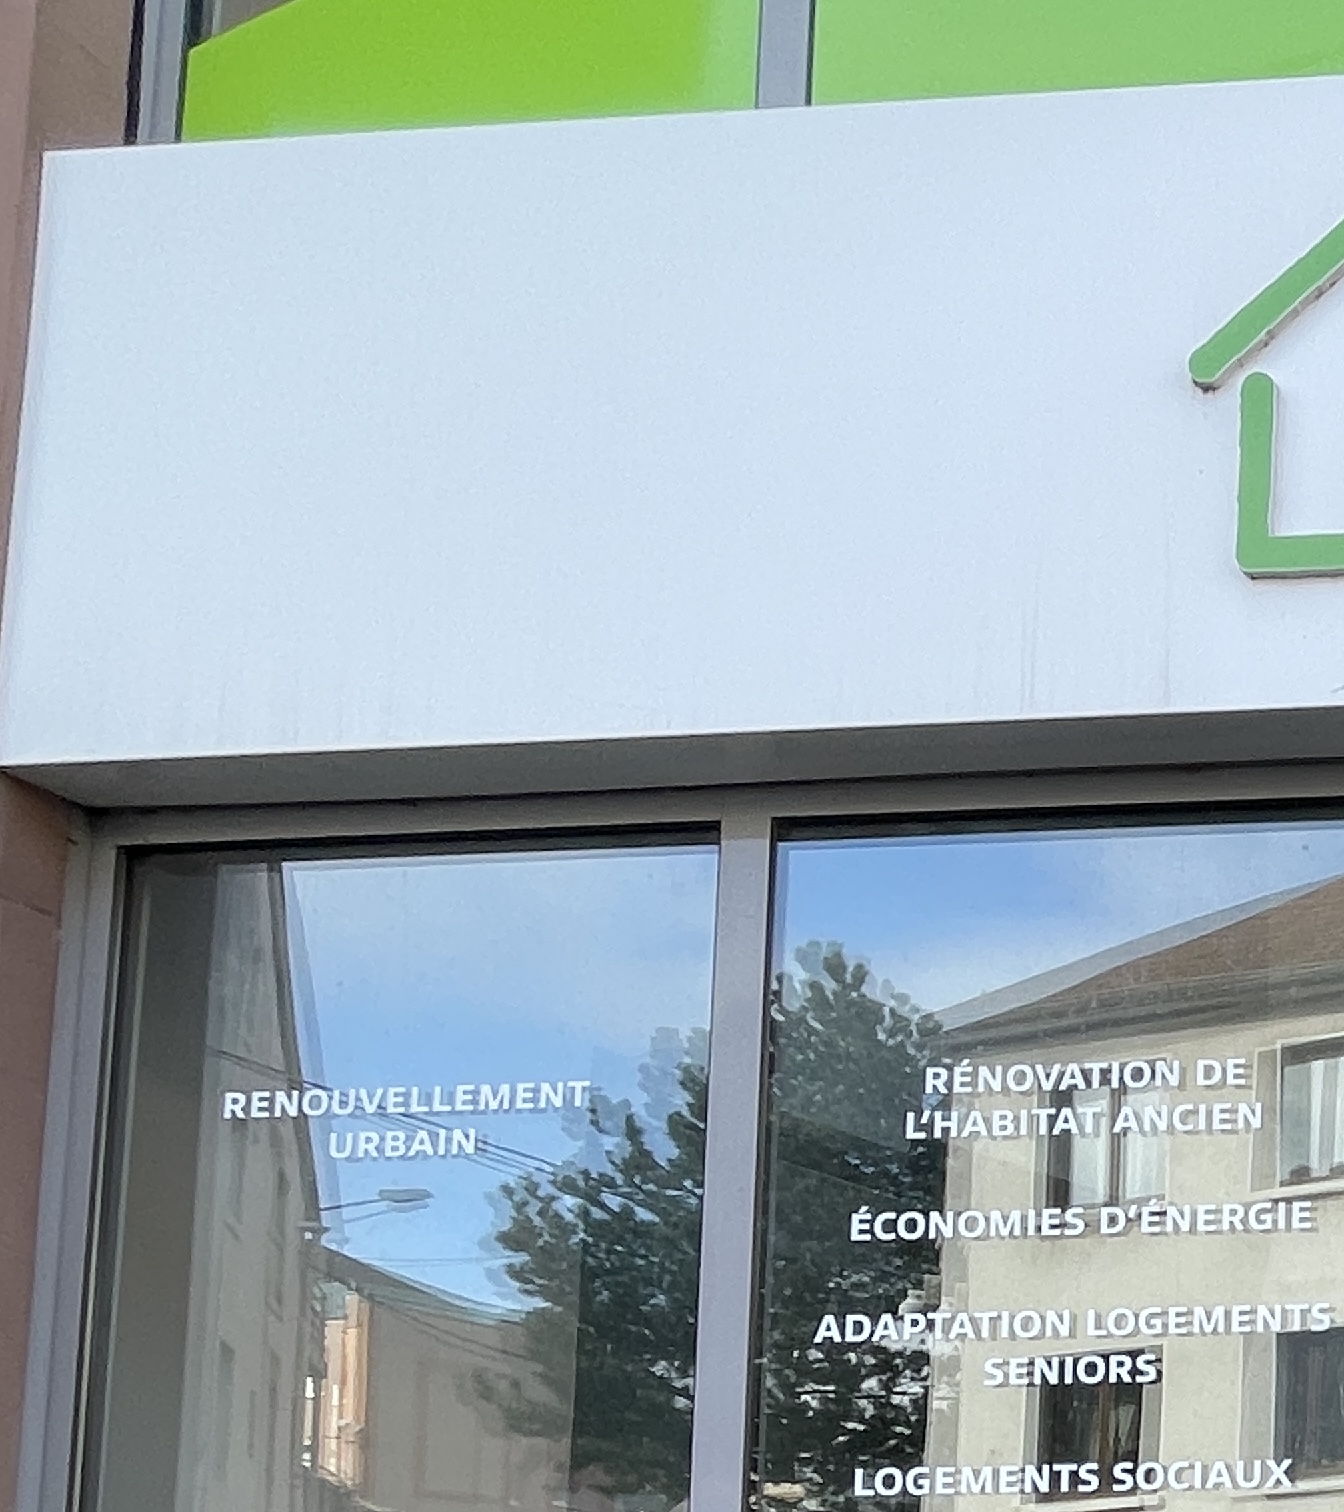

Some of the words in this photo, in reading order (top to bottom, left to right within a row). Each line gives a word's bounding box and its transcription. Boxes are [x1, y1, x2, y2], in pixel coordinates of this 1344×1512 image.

[924, 1057, 1181, 1095] RÉNOVATION
[1196, 1056, 1248, 1087] DE
[223, 1080, 592, 1120] RENOUVELLEMENT
[904, 1105, 1102, 1140] L'HABITAT
[1112, 1101, 1264, 1135] ANCIEN
[329, 1128, 477, 1159] URBAIN
[849, 1205, 1086, 1242] ÉCONOMIES
[1100, 1199, 1314, 1235] D'ÉNERGIE
[814, 1308, 1072, 1344] ADAPTATION
[1086, 1302, 1332, 1338] LOGEMENTS
[983, 1352, 1159, 1387] SENIORS
[853, 1461, 1100, 1497] LOGEMENTS
[1112, 1457, 1294, 1492] SOCIAUX
